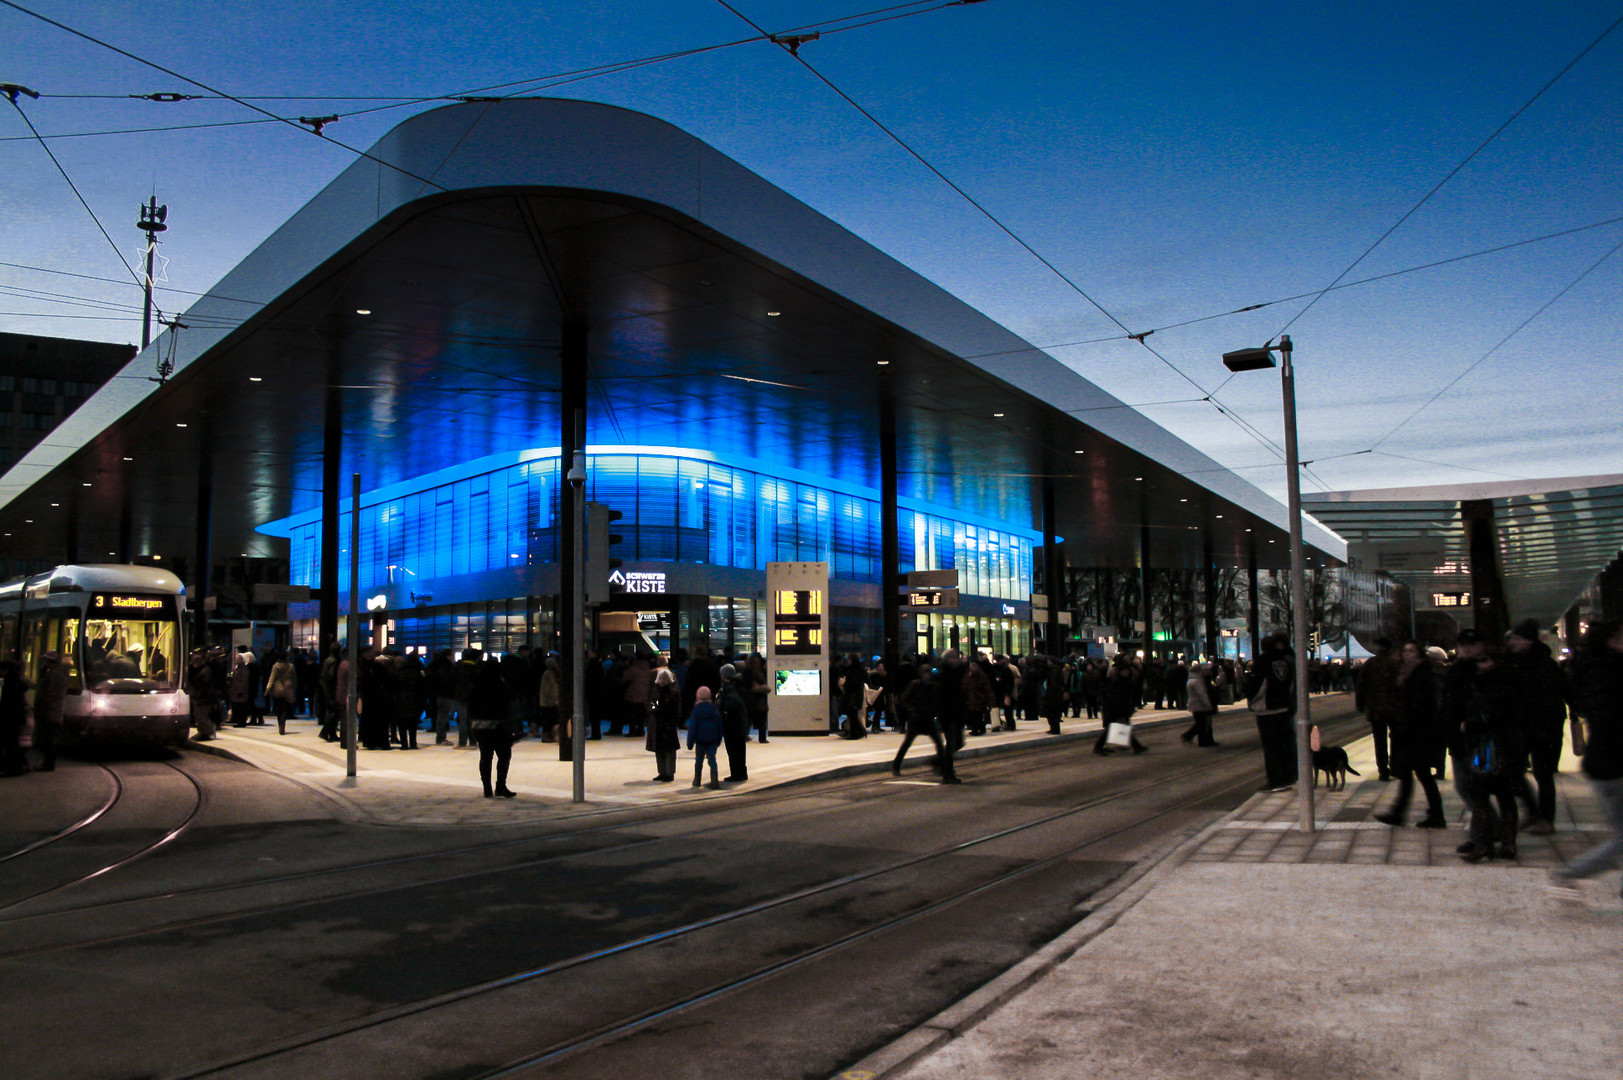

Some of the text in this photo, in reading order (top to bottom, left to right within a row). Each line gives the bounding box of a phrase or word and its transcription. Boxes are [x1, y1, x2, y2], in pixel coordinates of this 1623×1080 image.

[626, 580, 666, 593] KISTE
[96, 595, 163, 609] 3 Stadtbergen
